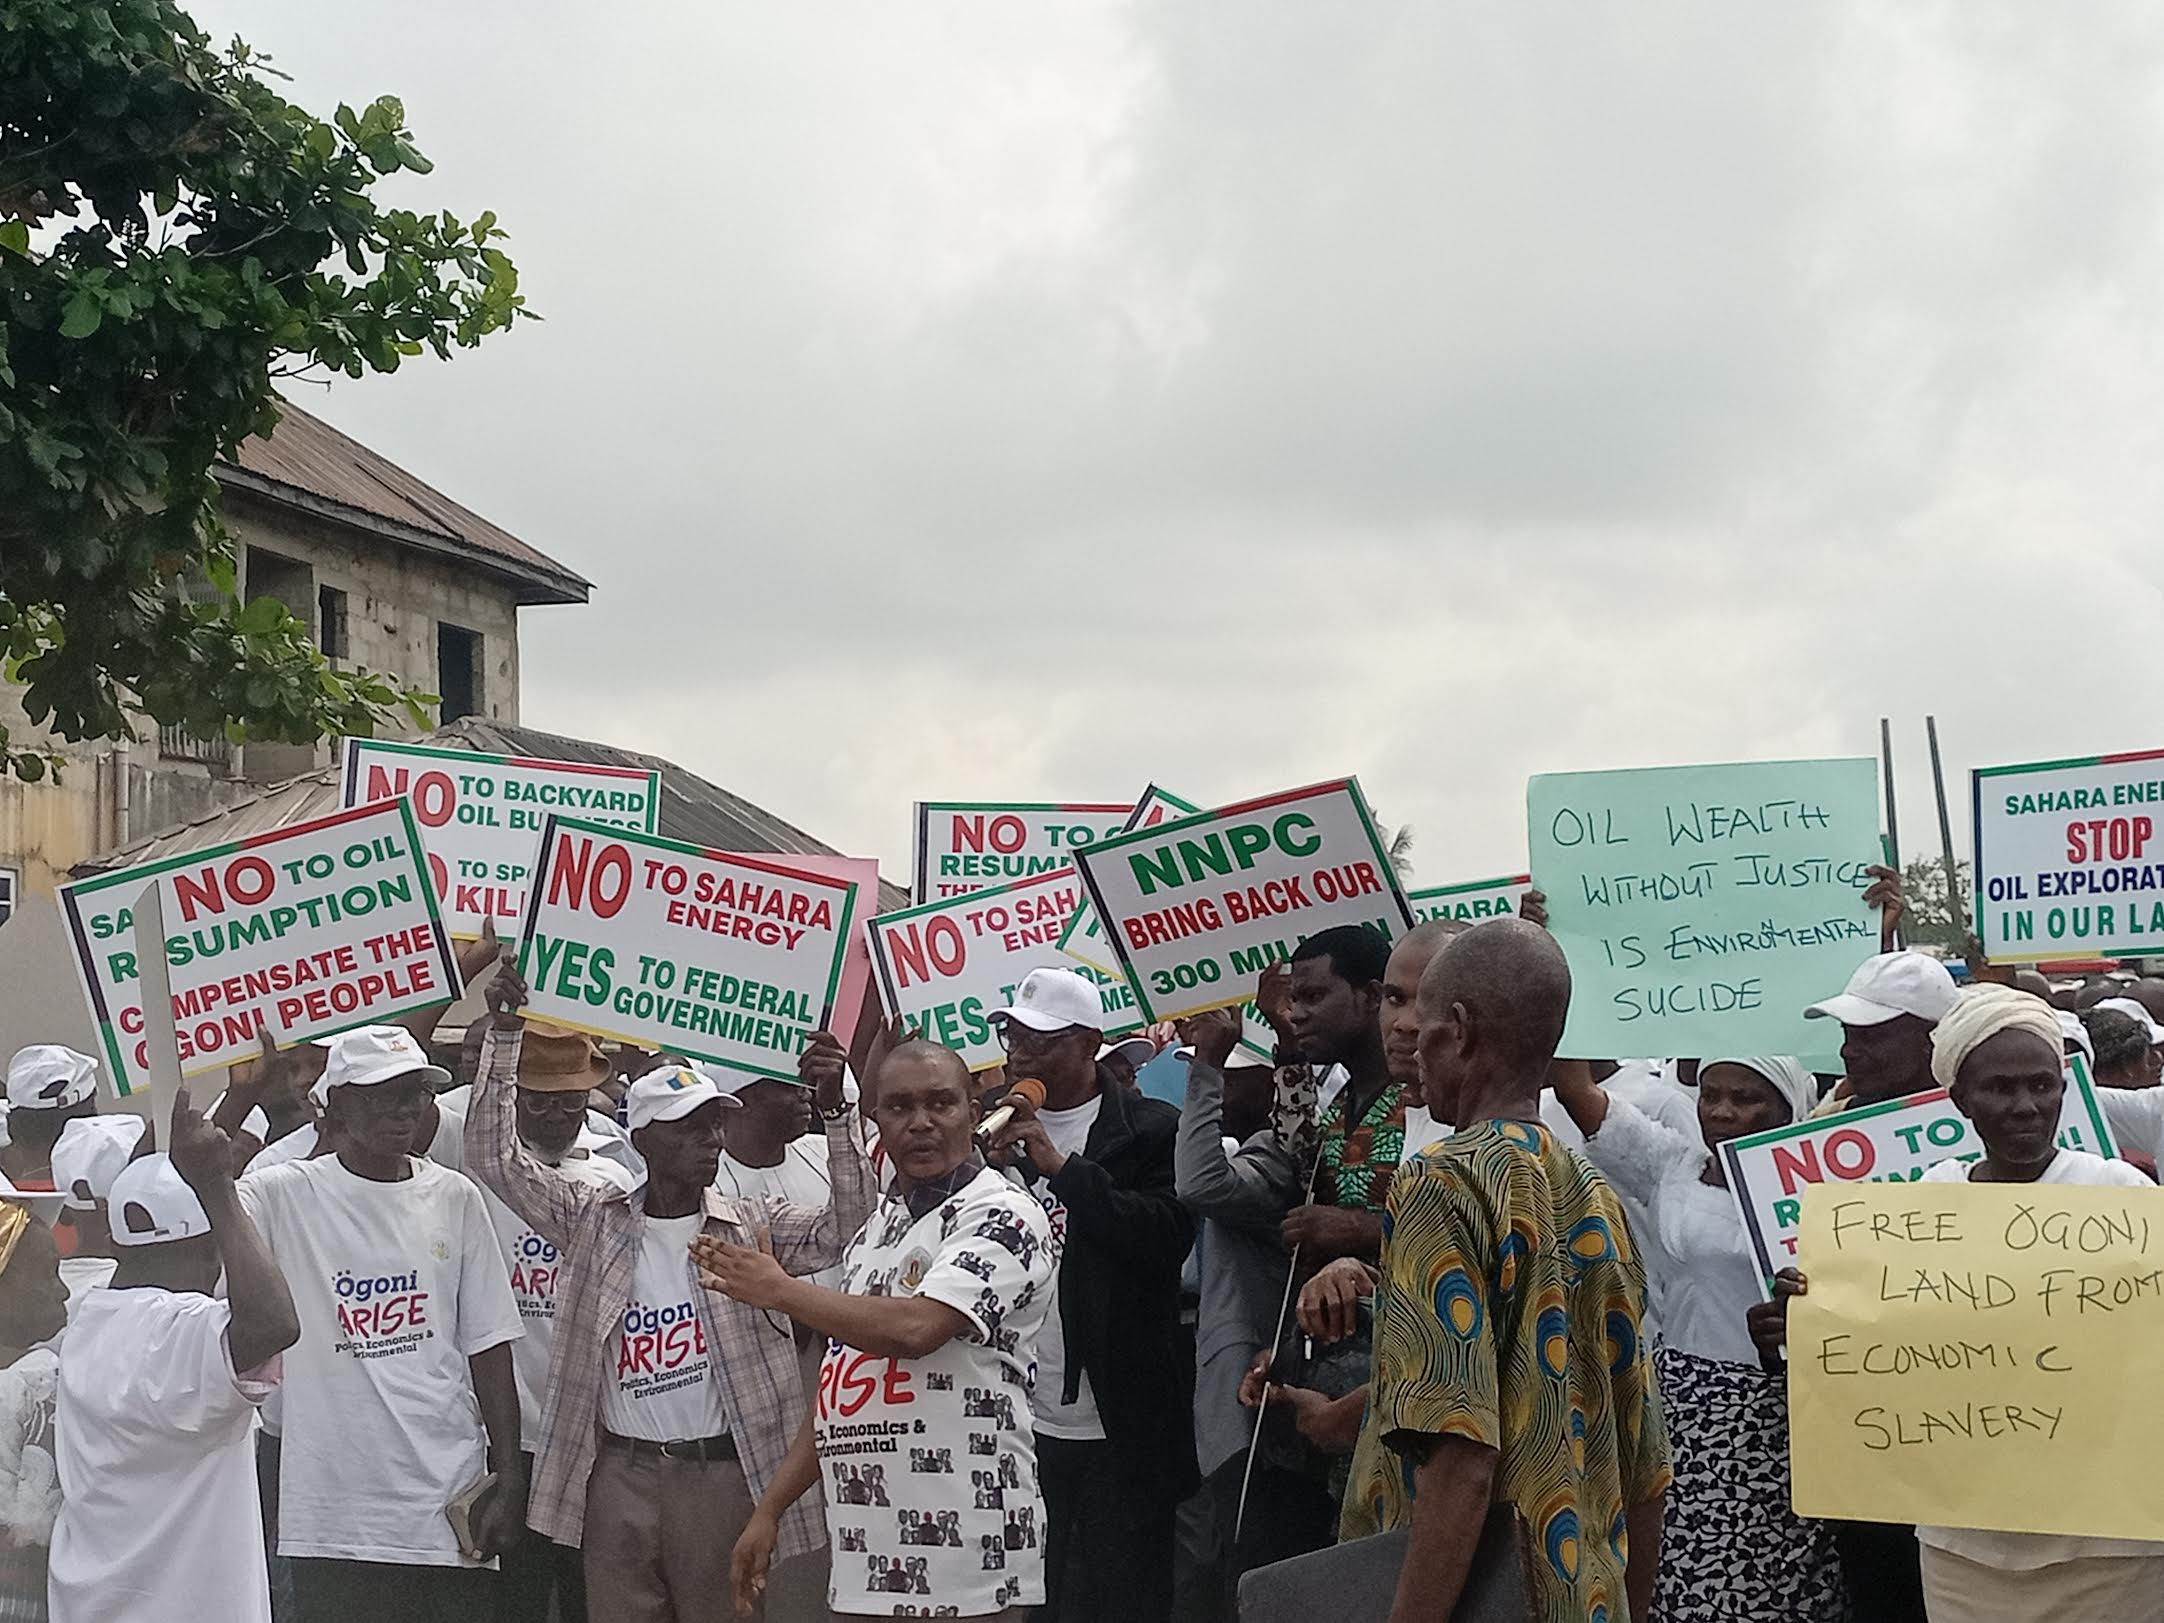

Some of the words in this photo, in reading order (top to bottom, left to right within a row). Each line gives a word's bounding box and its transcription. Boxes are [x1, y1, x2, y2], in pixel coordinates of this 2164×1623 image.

[457, 803, 500, 828] OIL
[458, 775, 495, 798] TO
[503, 780, 646, 813] BACKYARD
[2005, 787, 2108, 816] SAHARA
[2113, 780, 2164, 806] ENE
[952, 815, 1027, 853] NO
[1044, 826, 1095, 847] TO
[1552, 807, 1629, 847] OIL
[1665, 800, 1831, 847] WEALTH
[2066, 816, 2153, 864] STOP
[457, 859, 488, 879] TO
[1127, 813, 1322, 896] NNPC
[173, 856, 276, 923] NO
[282, 854, 335, 886] TO
[343, 835, 407, 869] OIL
[547, 833, 633, 919] NO
[643, 859, 688, 895] TO
[694, 872, 833, 931] SAHARA
[1582, 862, 1718, 908] WITHOUT
[1734, 855, 1869, 889] JUSTICE
[1988, 876, 2028, 902] OIL
[107, 874, 413, 984] RSUMPTION
[666, 901, 807, 951] ENERGY
[1122, 898, 1224, 950] BRING
[1222, 875, 1313, 925] BACK
[1312, 862, 1383, 903] OUR
[2002, 910, 2034, 942] IN
[2047, 905, 2115, 939] OUR
[886, 914, 967, 988] NO
[966, 907, 1009, 936] TO
[1601, 936, 1647, 970] IS
[119, 945, 359, 1035] CMPENSATE
[364, 924, 436, 965] THE
[276, 960, 436, 1030] PEOPLE
[533, 933, 616, 1006] YES
[638, 955, 676, 990] TO
[683, 966, 815, 1024] FEDERAL
[1150, 957, 1222, 996] 300
[613, 986, 809, 1057] GOVERNMENT
[1613, 979, 1763, 1023] SUCIDE
[1771, 1129, 1876, 1197] NO
[1895, 1118, 1966, 1155] TO
[1831, 1201, 1963, 1250] FREE
[1880, 1265, 2016, 1311] LAND
[2037, 1269, 2164, 1317] FROM
[337, 1293, 429, 1340] ARISE
[1816, 1335, 2073, 1375] ECONOMIC
[829, 1420, 909, 1439] Economics
[913, 1418, 927, 1434] &
[1854, 1402, 2063, 1450] SLAVERY
